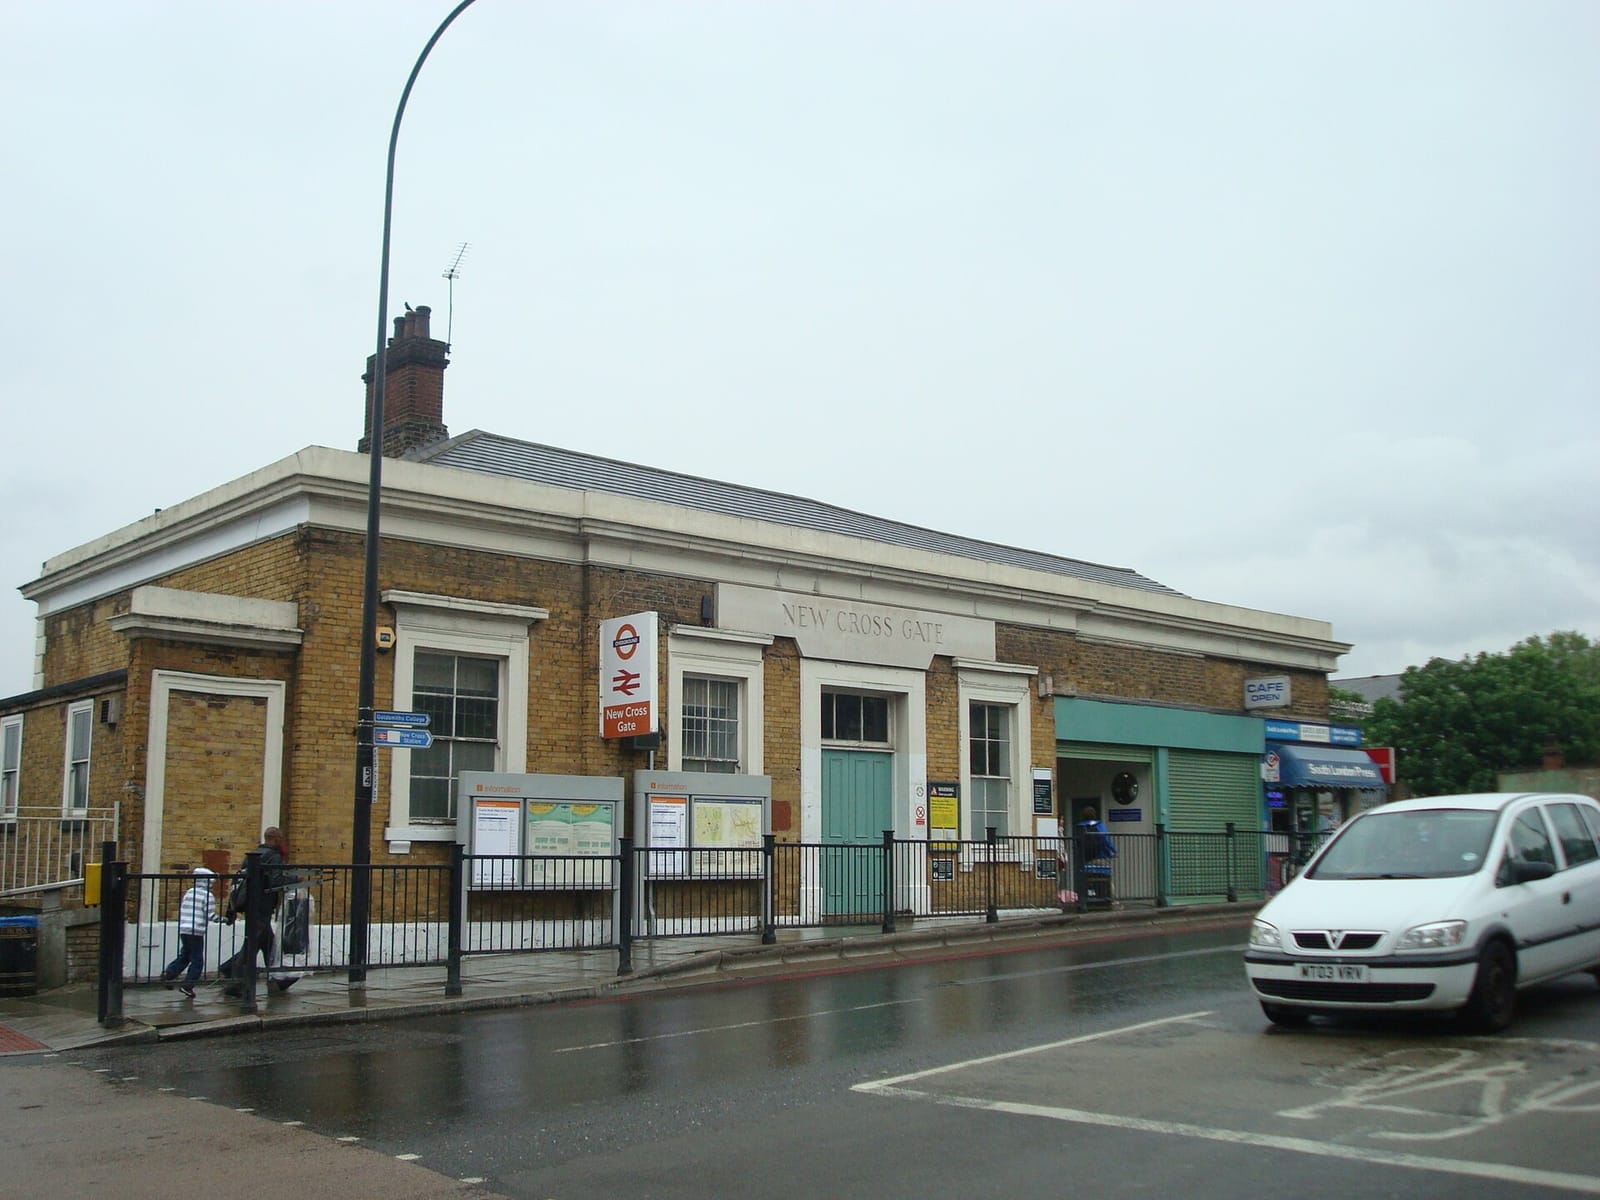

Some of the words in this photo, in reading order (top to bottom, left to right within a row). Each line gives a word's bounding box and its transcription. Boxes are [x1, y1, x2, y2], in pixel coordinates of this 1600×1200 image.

[783, 603, 830, 631] NEW
[836, 610, 893, 637] CROSS
[902, 620, 943, 644] GATE
[615, 637, 638, 647] OVERGROUND
[1247, 682, 1284, 693] CAFE
[1251, 693, 1281, 702] OPEN
[606, 709, 624, 720] New
[625, 706, 648, 717] Cross
[617, 721, 636, 732] Gate
[484, 785, 521, 793] information
